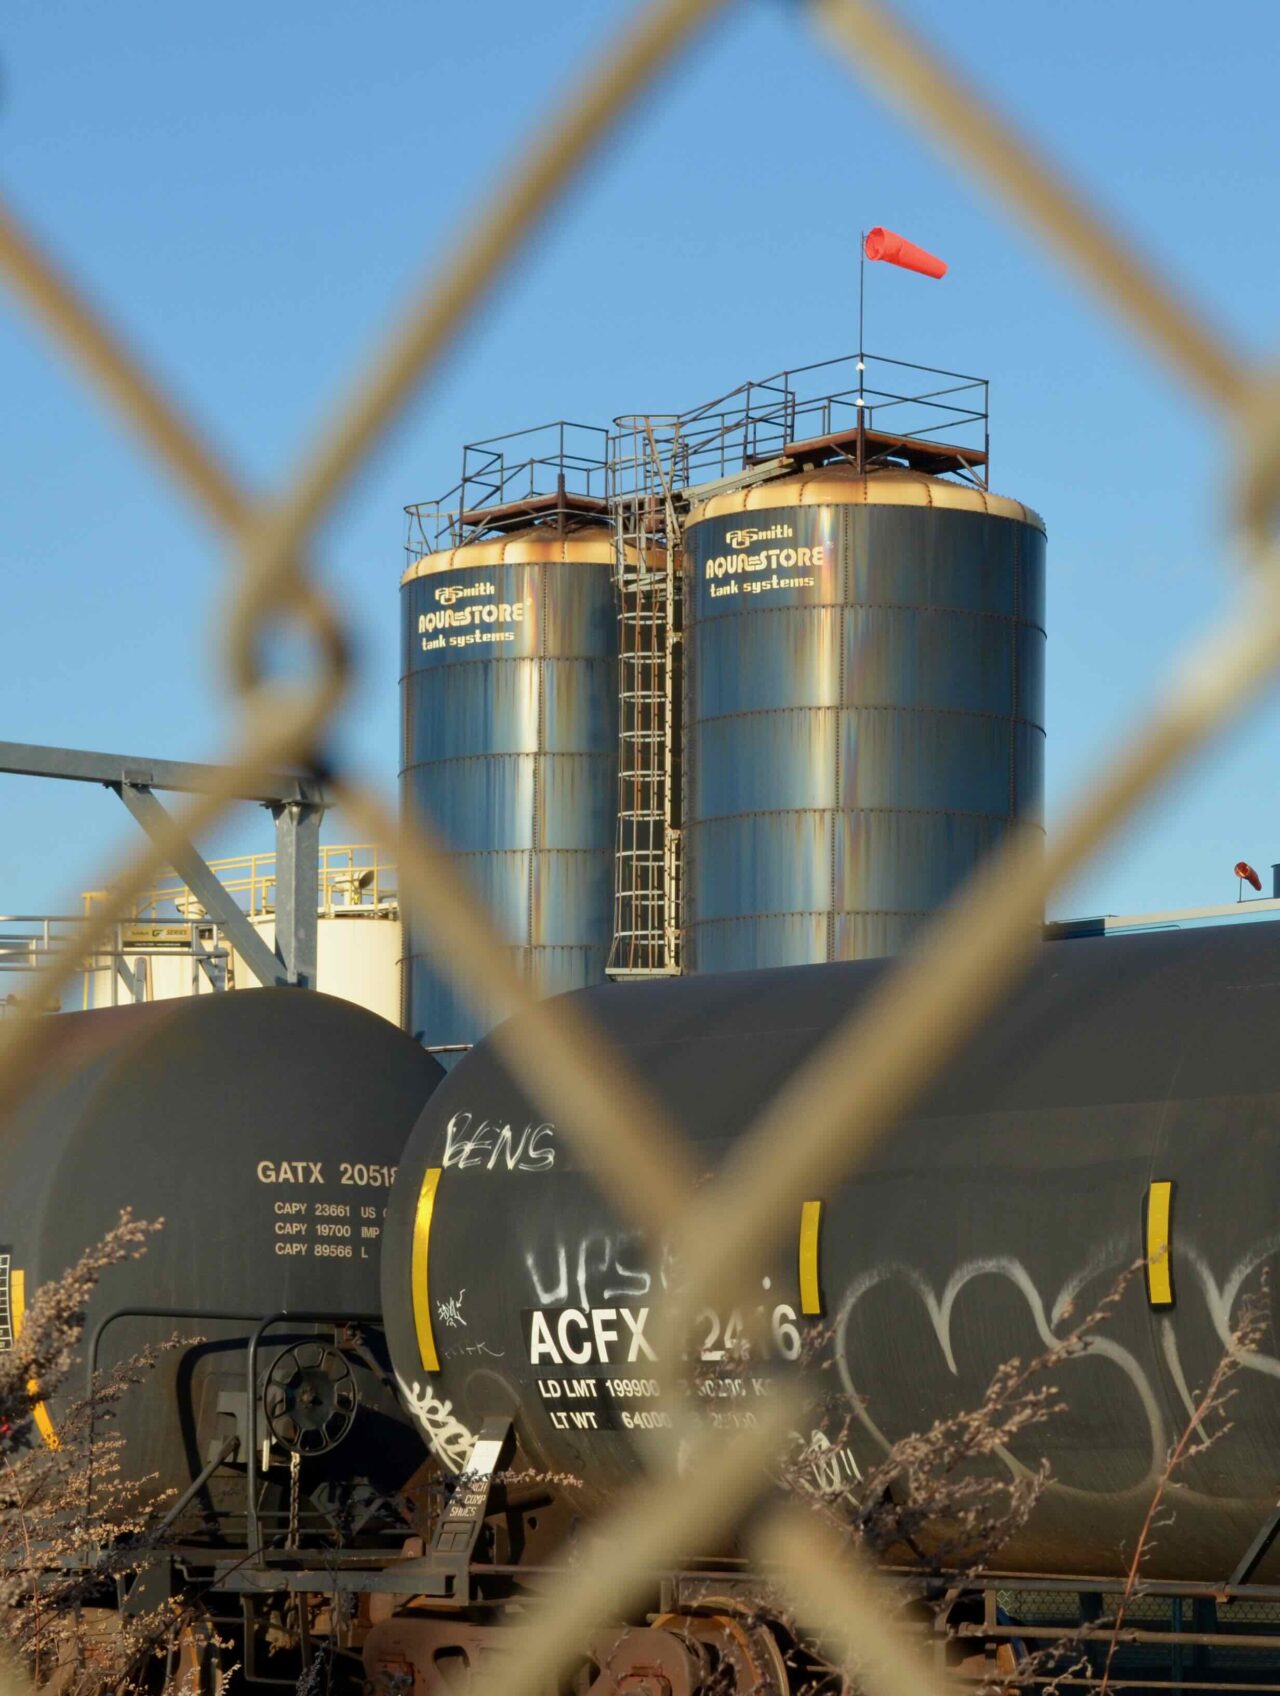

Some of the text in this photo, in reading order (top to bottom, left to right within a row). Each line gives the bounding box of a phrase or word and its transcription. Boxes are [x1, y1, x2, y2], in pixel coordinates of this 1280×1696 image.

[710, 574, 815, 597] tank systems
[422, 629, 515, 650] tank systems
[257, 1160, 325, 1184] GATX
[274, 1202, 307, 1215] CAPY
[314, 1203, 350, 1217] 23661
[361, 1206, 376, 1218] US
[275, 1222, 380, 1239] CAPY 19700 IMP
[275, 1242, 369, 1259] CAPY 89566 L
[530, 1307, 659, 1365] ACFX
[537, 1380, 562, 1398] LD
[563, 1379, 598, 1398] LMT
[605, 1379, 661, 1398] 199900
[550, 1412, 569, 1429] LT
[570, 1412, 599, 1430] WT
[449, 1506, 477, 1517] SHOES
